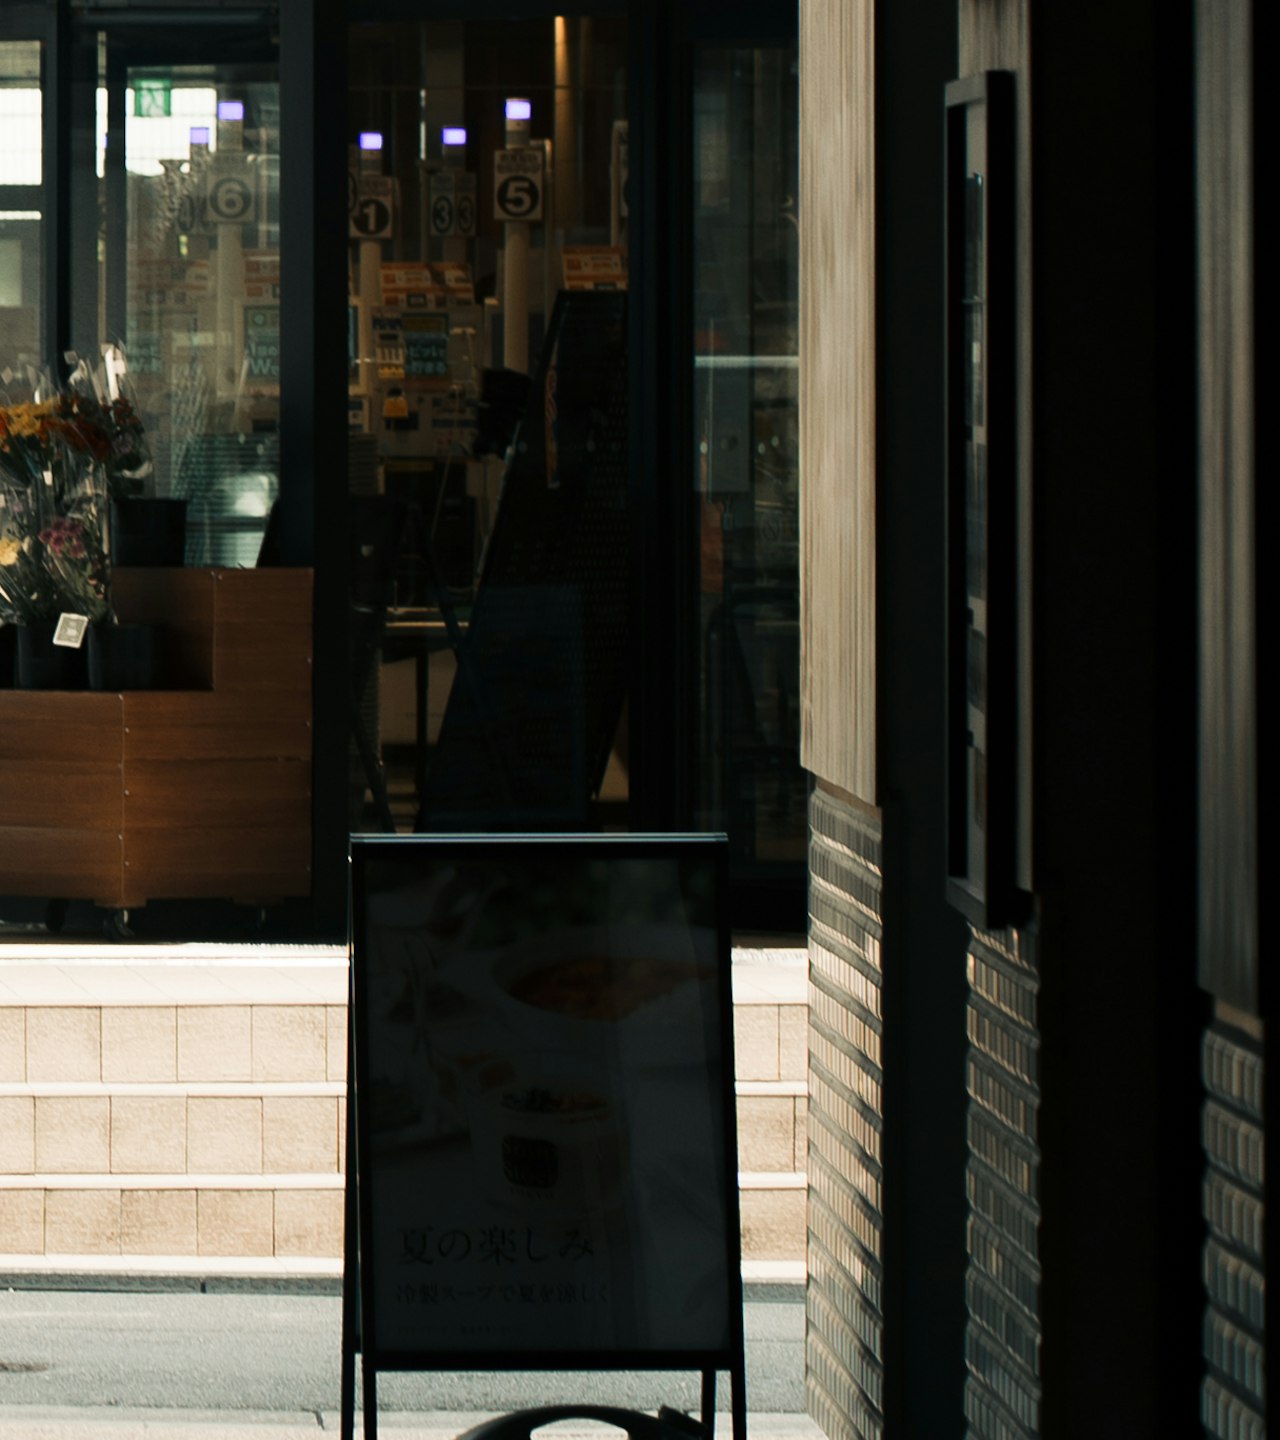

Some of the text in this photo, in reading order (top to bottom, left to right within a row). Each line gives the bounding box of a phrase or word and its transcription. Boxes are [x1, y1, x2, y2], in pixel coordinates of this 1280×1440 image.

[506, 181, 532, 208] 5
[398, 1225, 596, 1266] 夏の楽しみ
